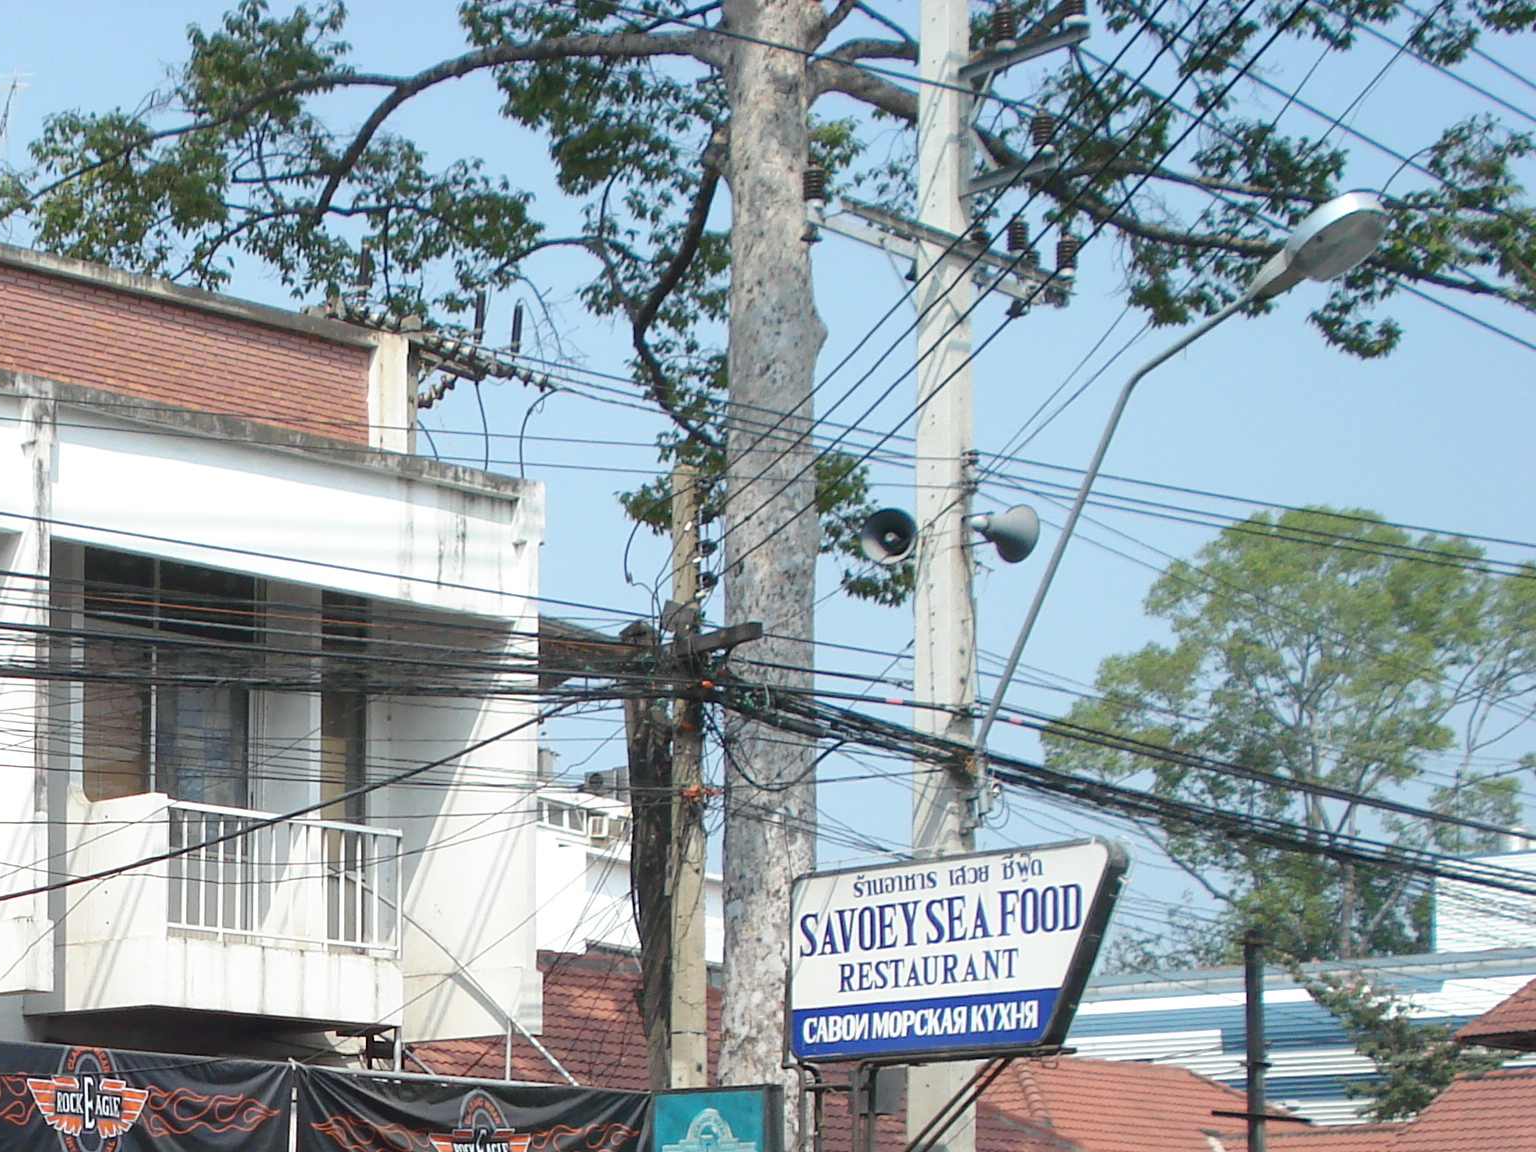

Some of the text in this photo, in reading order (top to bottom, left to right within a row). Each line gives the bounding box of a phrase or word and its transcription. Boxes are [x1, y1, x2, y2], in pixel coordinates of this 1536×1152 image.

[853, 870, 938, 898] ร้านอาหาร
[948, 864, 990, 886] เสวย
[799, 884, 1083, 957] SAVOEY SEA FOOD
[838, 948, 1019, 993] RESTAURANT
[871, 1004, 968, 1040] МОРСКАЯ
[970, 1000, 1039, 1033] КУХНЯ
[56, 1091, 84, 1114] ROCK
